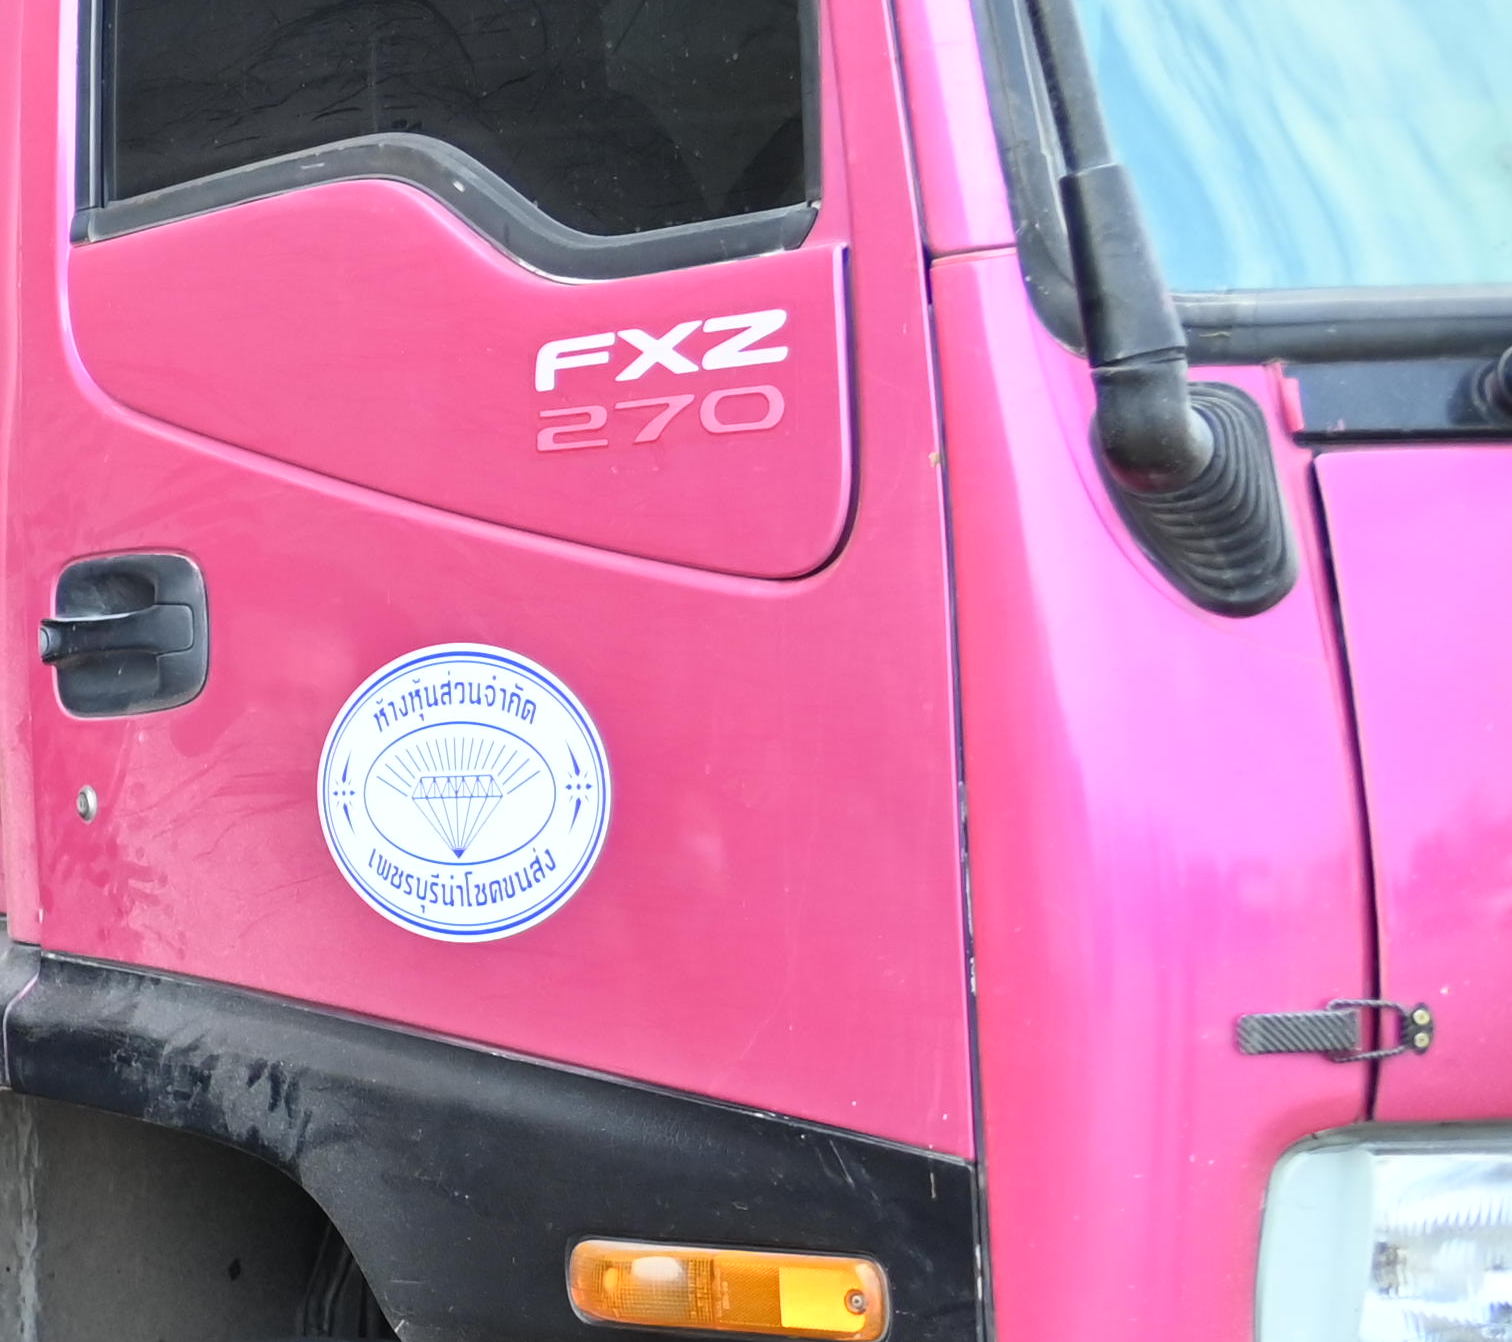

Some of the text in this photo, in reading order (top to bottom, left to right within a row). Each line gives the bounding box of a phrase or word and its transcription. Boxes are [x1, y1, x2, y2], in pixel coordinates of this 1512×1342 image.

[534, 308, 789, 392] FXZ
[537, 384, 785, 452] 270
[373, 670, 537, 733] ห้างหุ้นส่วนจำกัด
[368, 847, 556, 914] เพชรบุรีนำโชคขนส่ง
